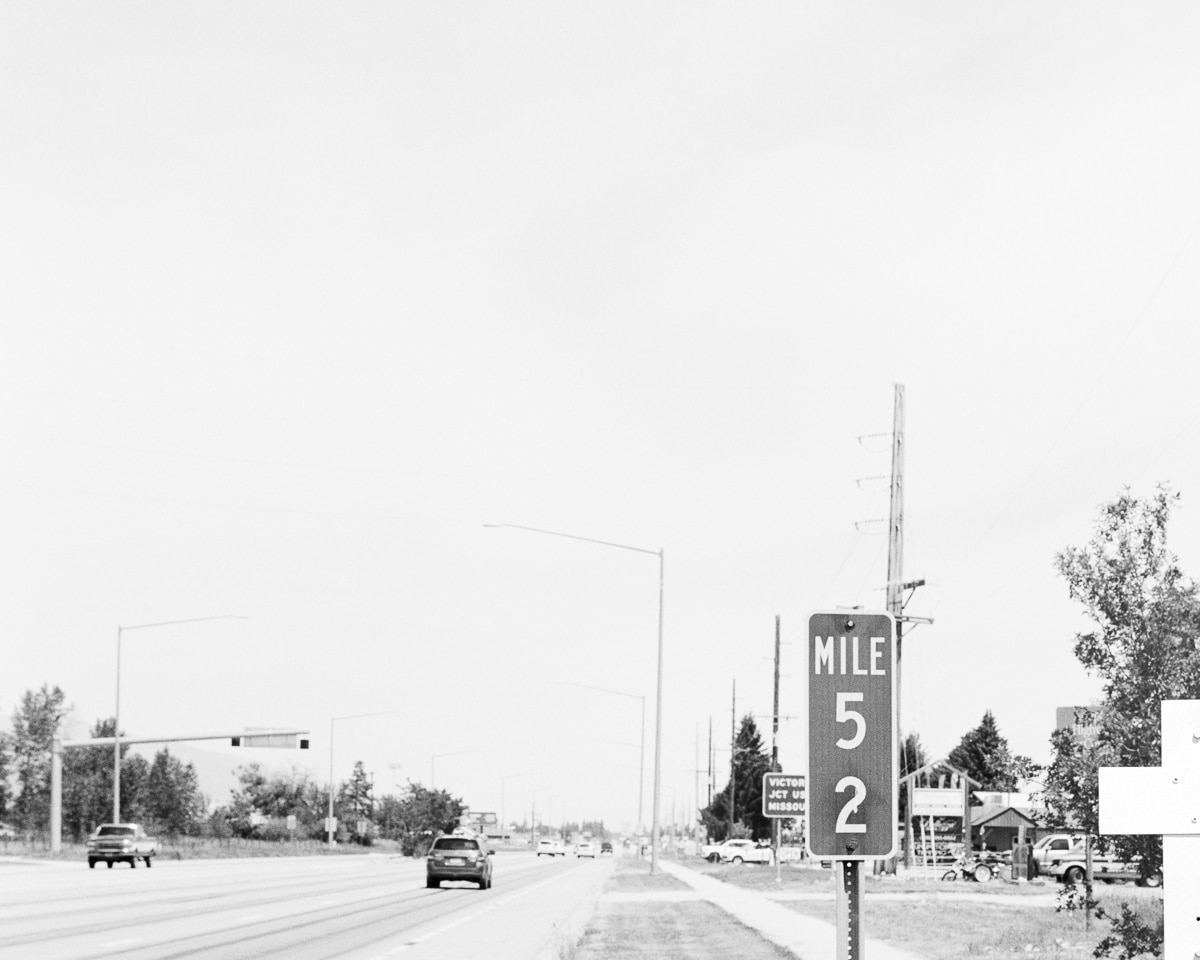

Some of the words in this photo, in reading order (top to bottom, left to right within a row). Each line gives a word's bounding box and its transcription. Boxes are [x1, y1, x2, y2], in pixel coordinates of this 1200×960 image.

[814, 636, 886, 675] MILE
[836, 692, 867, 750] 5
[769, 777, 805, 787] VICTOR
[769, 790, 788, 799] JCT
[792, 790, 805, 799] US
[835, 776, 867, 833] 2
